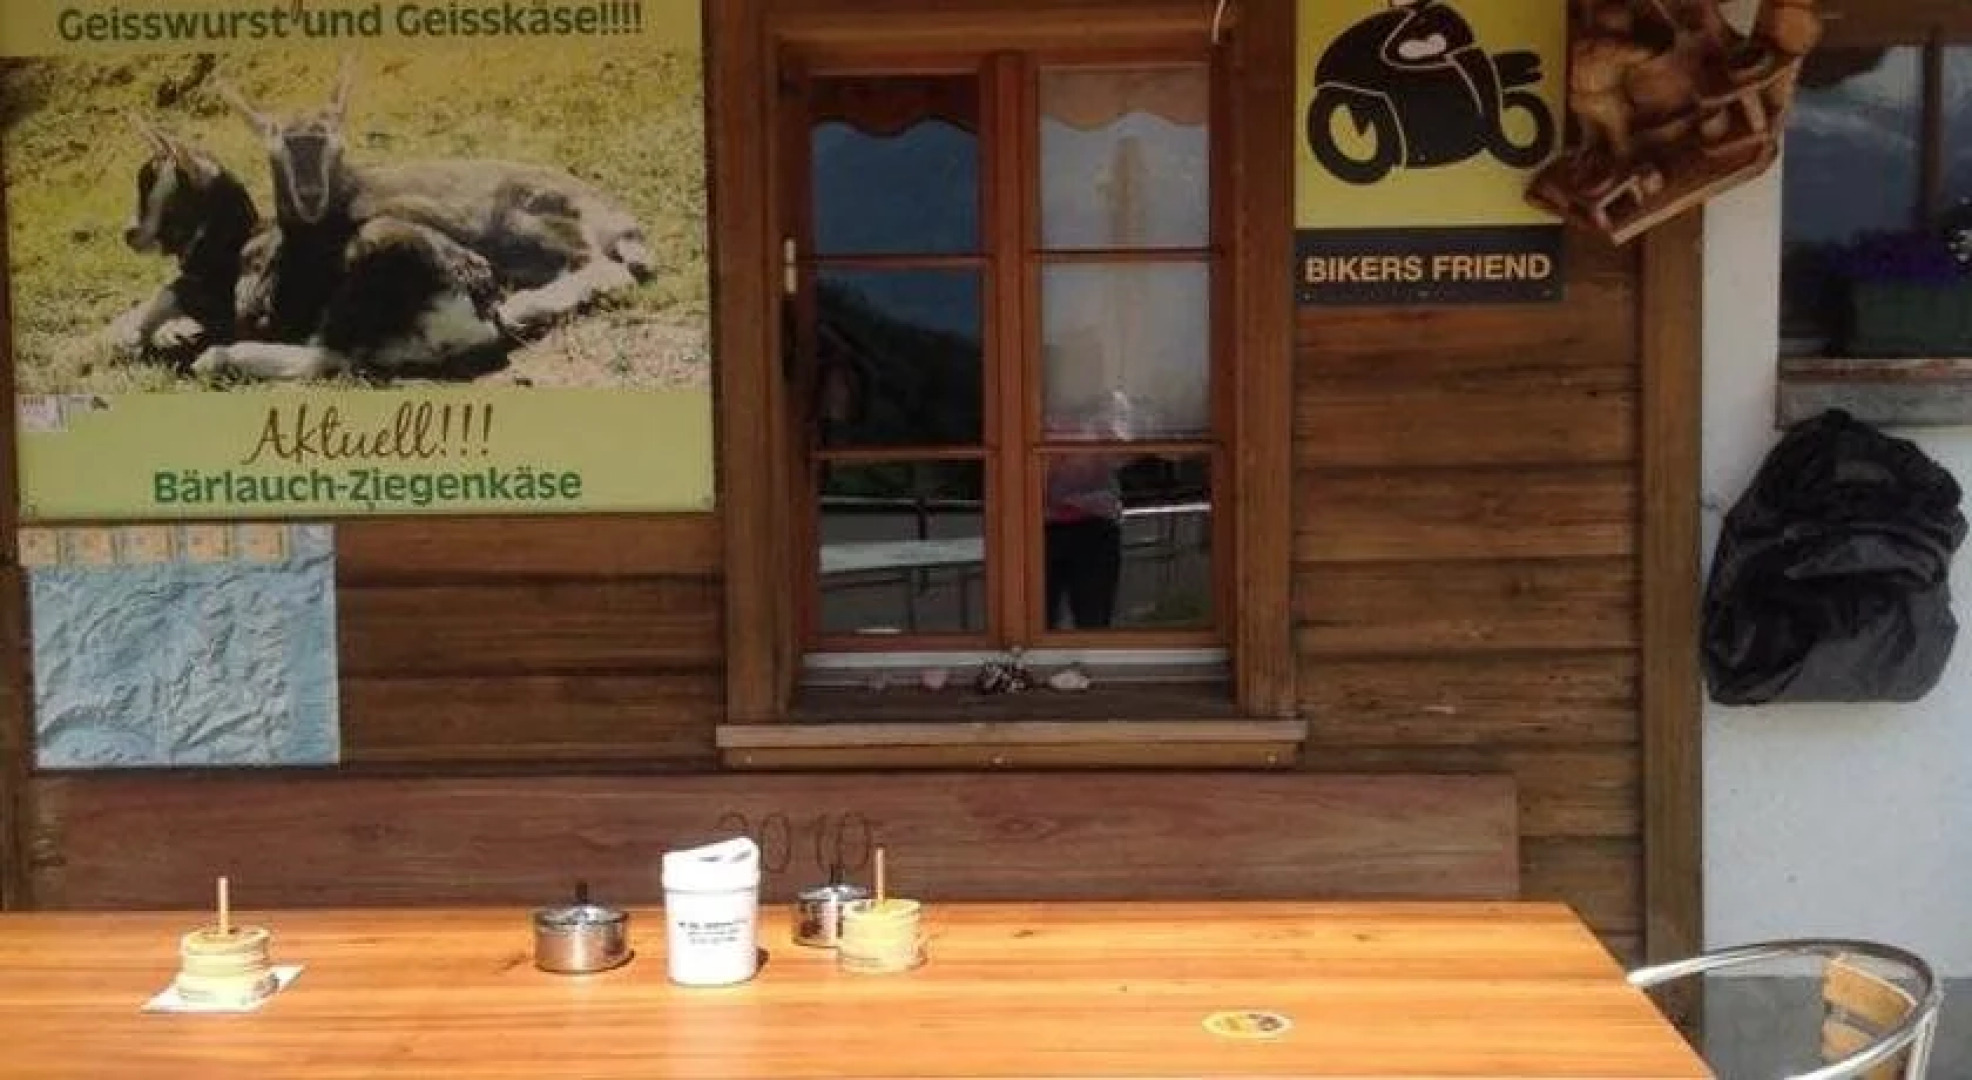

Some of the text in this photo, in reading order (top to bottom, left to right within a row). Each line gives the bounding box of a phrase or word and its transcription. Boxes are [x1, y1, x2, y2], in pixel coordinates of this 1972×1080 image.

[58, 7, 289, 41] Geisswurst
[302, 3, 382, 38] und
[1305, 253, 1551, 283] BIKERS FRIEND
[240, 400, 495, 466] Aktuell!!!
[153, 466, 583, 508] Bärlauch-Ziegenkäse
